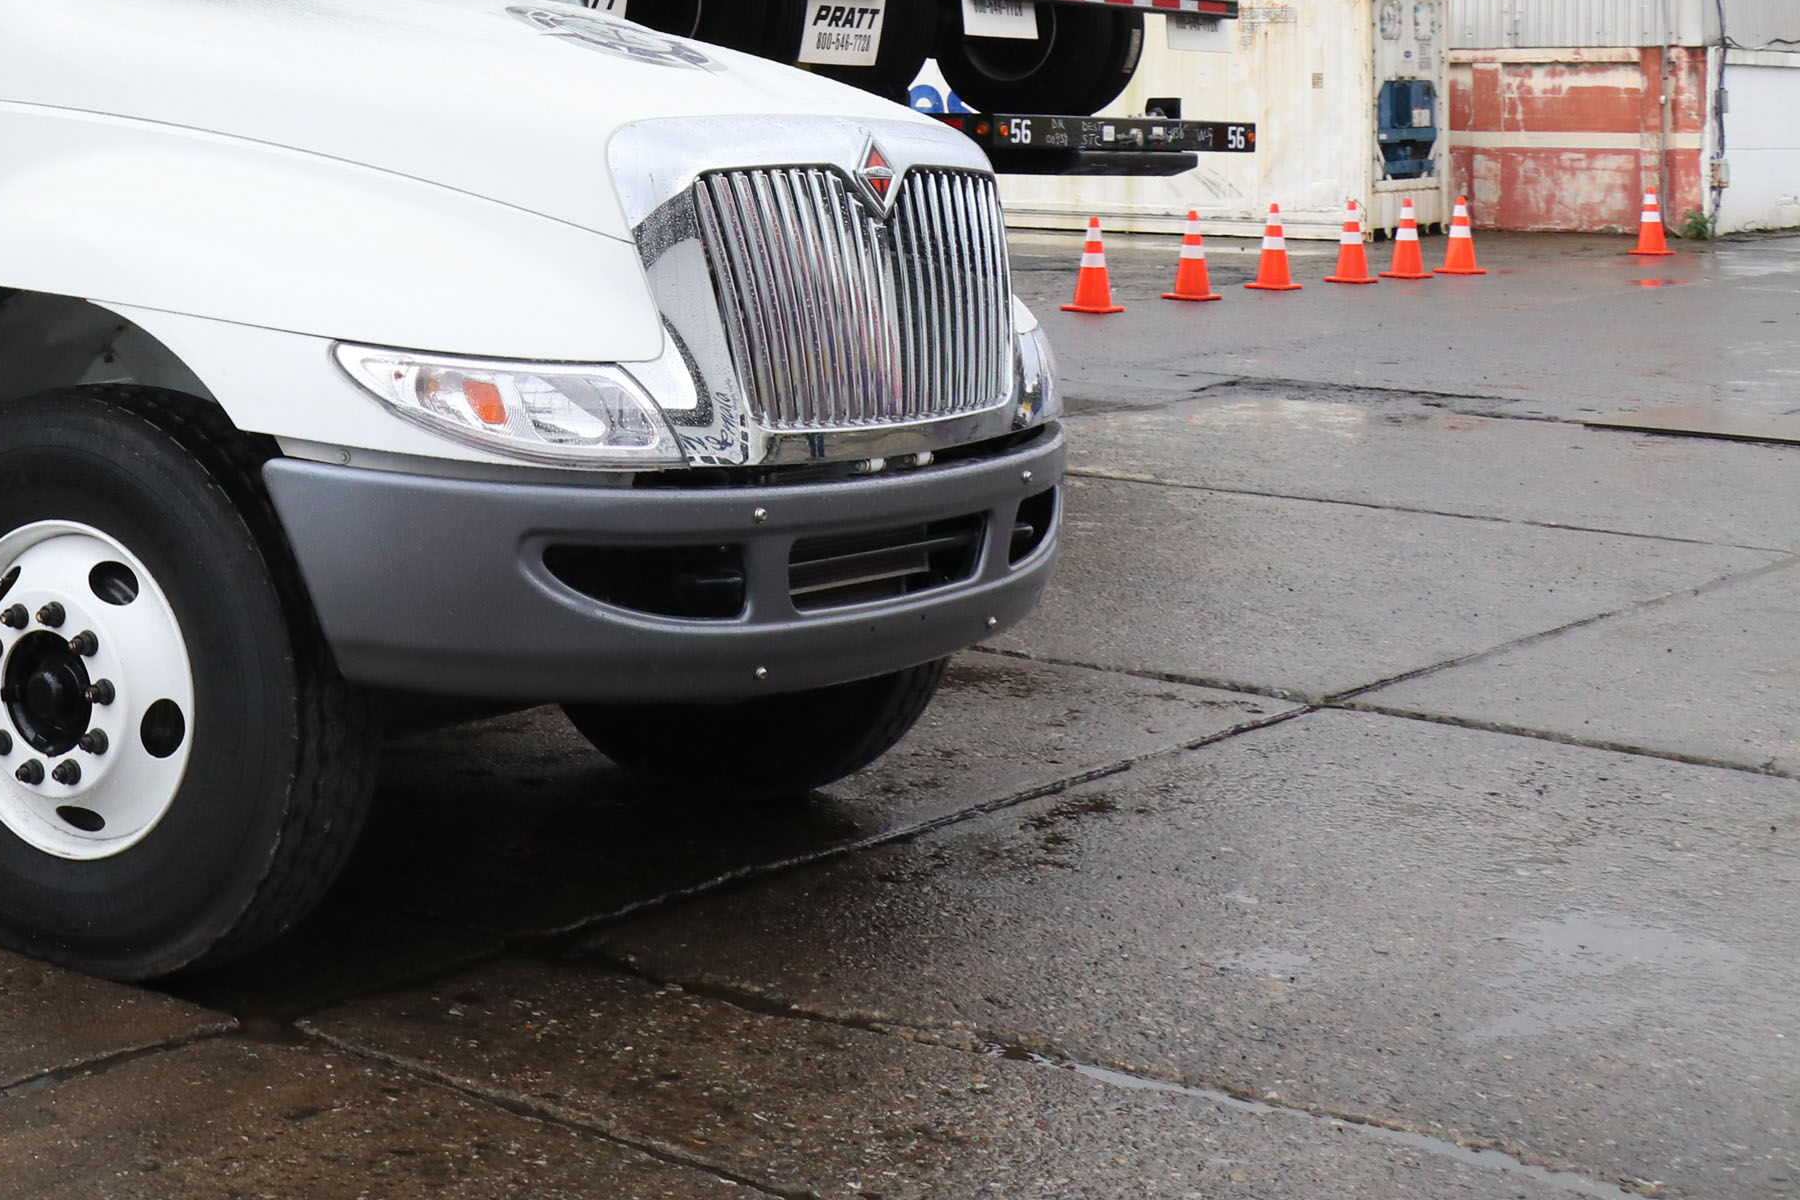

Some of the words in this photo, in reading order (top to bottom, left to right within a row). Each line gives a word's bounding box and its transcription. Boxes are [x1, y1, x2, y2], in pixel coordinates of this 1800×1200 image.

[812, 4, 881, 30] PRATT
[816, 31, 872, 53] 800-546-7728
[1010, 117, 1032, 145] 56
[1227, 125, 1246, 150] 56
